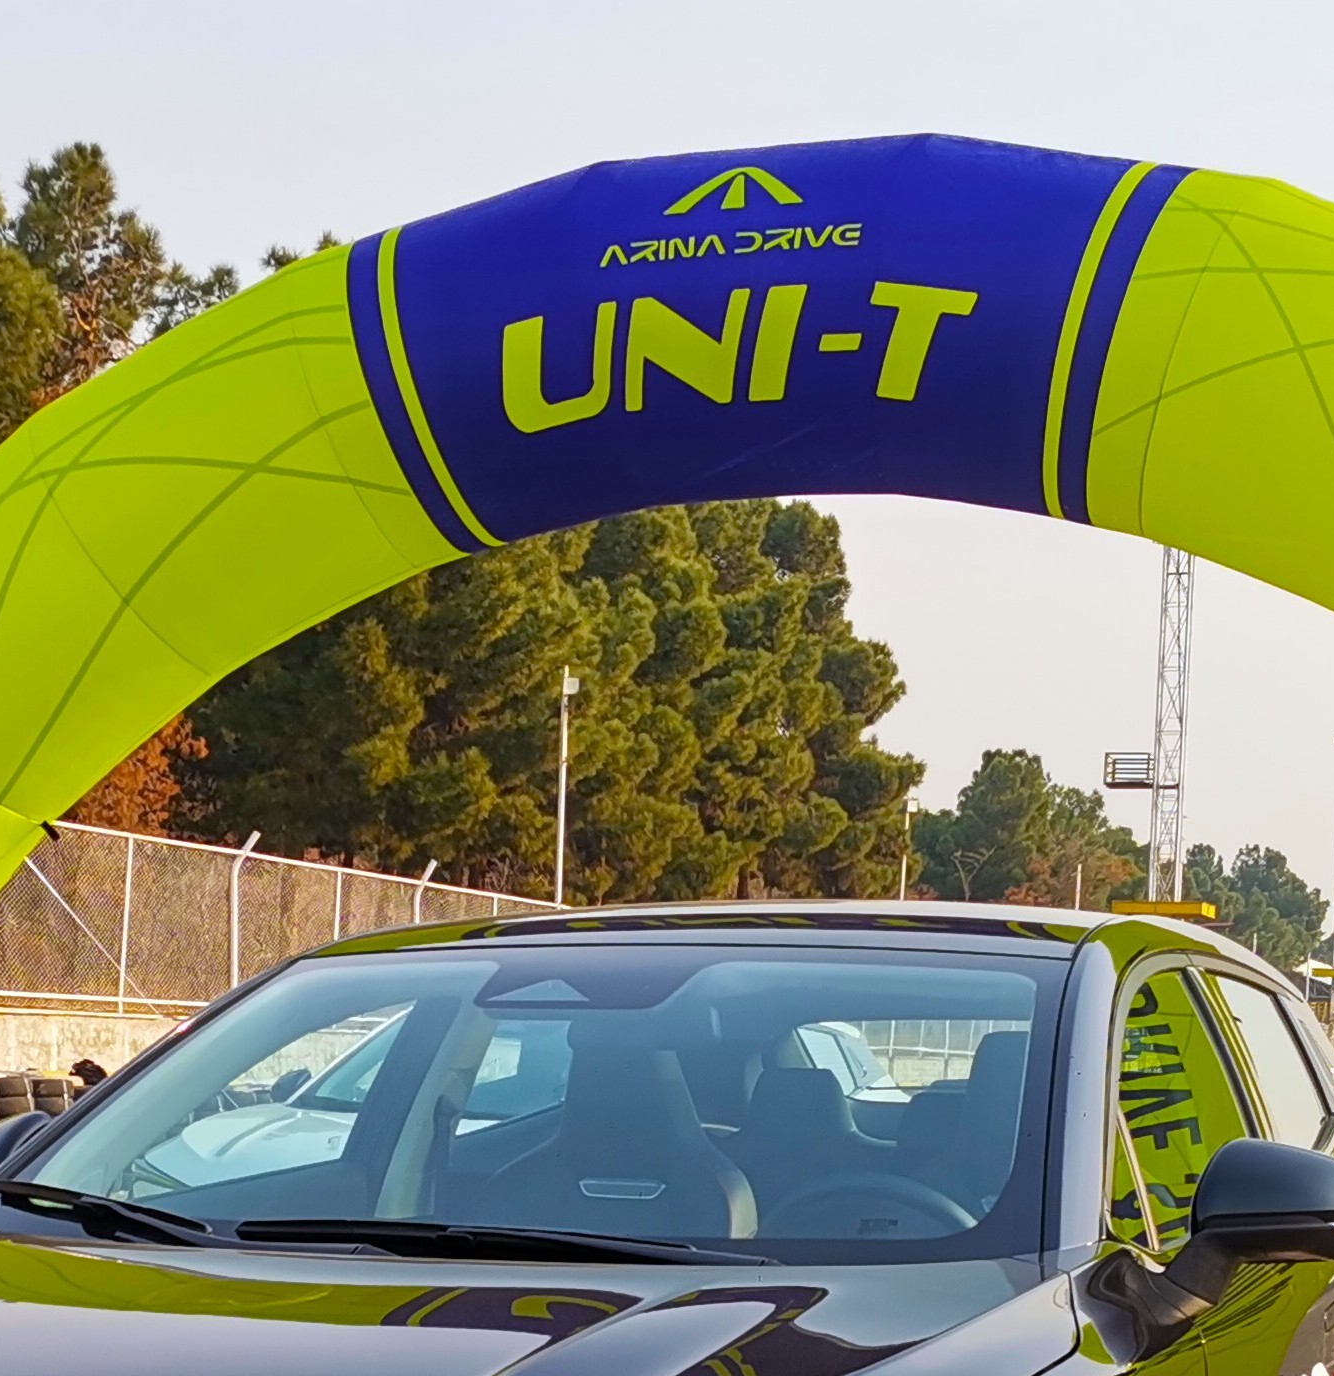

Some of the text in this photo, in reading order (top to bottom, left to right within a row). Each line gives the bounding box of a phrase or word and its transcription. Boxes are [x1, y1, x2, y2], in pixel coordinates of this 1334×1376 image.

[599, 223, 863, 268] ARINA DRIVE
[502, 281, 979, 434] UNI-T
